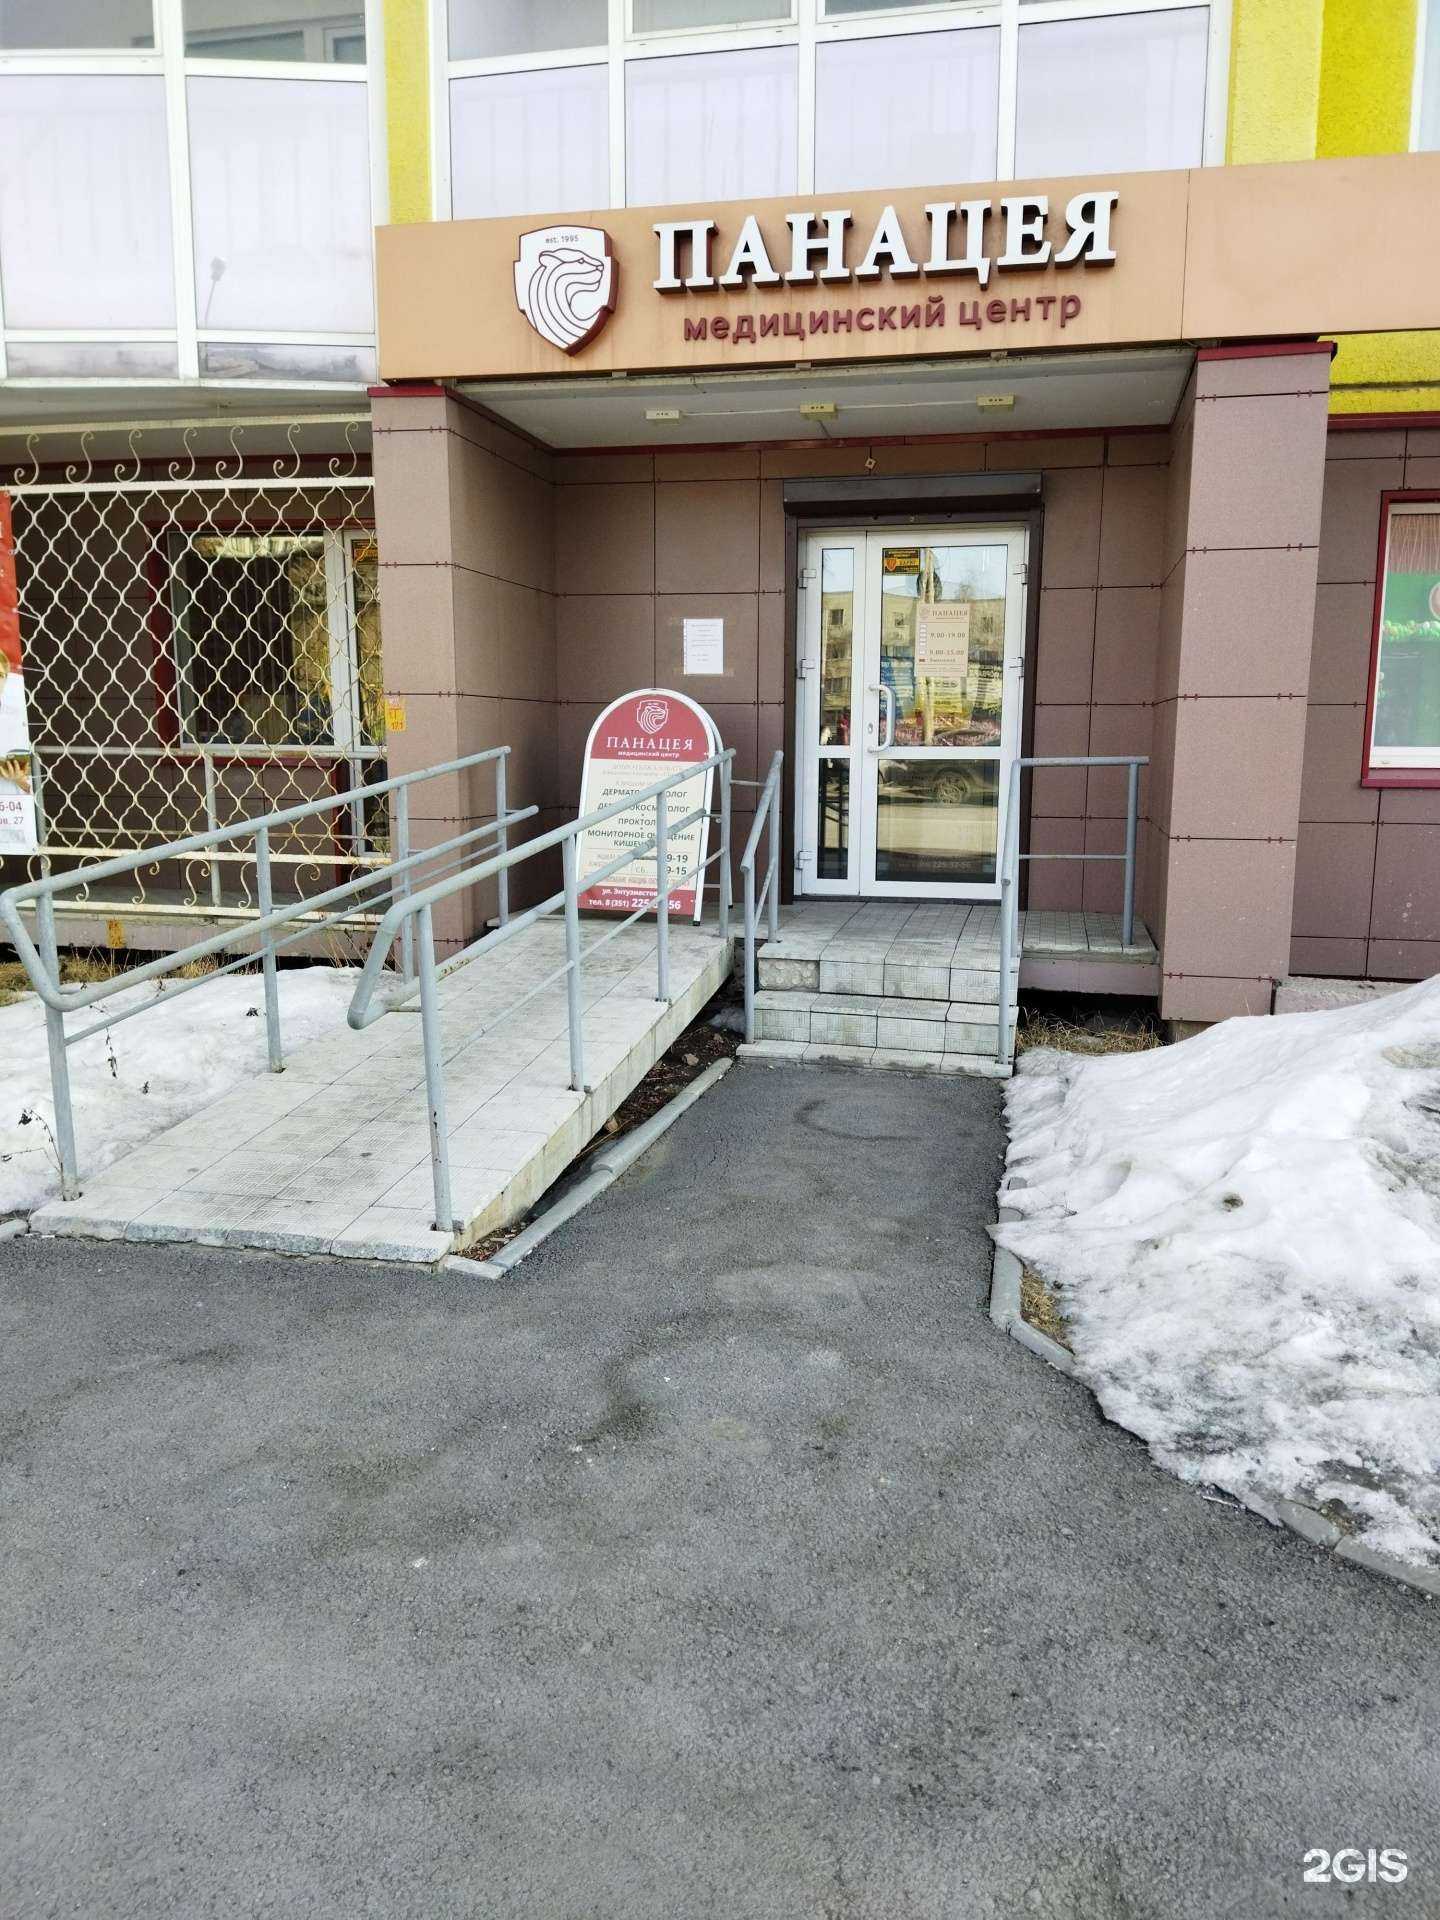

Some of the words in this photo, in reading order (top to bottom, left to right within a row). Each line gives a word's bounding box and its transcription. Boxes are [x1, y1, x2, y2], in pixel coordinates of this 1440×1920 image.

[653, 191, 1119, 291] ПАНАЦЕЯ
[684, 295, 945, 344] медицинский
[959, 294, 1081, 329] центр
[606, 736, 693, 751] ПАНАЦЕЯ
[14, 816, 24, 825] 27
[587, 829, 646, 839] МОНИТОРНОЕ
